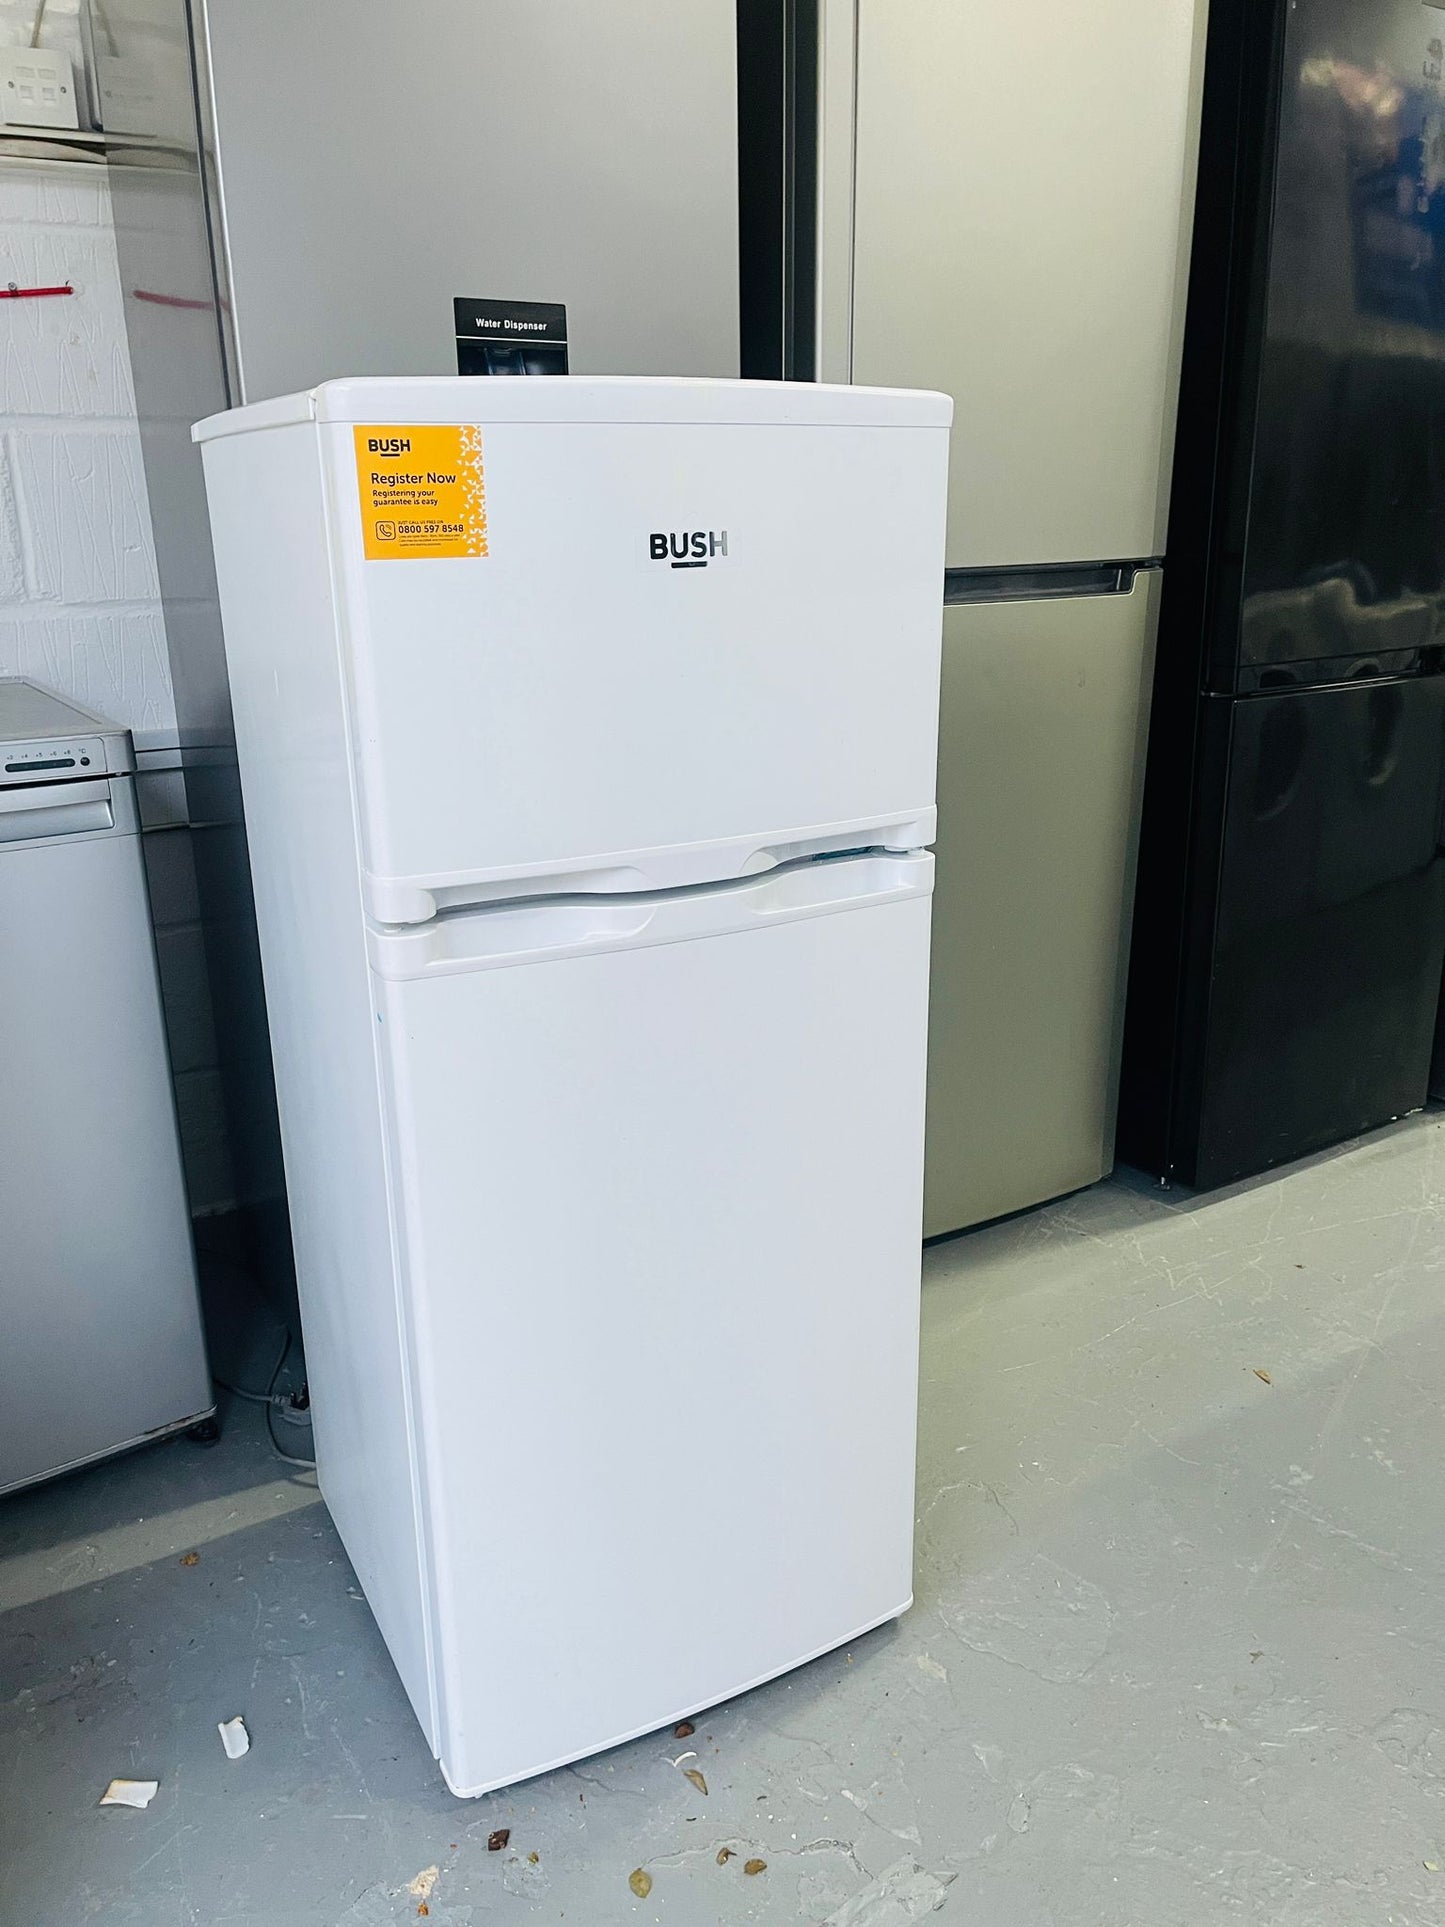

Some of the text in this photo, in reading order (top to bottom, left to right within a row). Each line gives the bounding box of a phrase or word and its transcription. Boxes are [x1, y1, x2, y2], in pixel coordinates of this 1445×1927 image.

[475, 318, 548, 331] Water Dispenser
[368, 439, 411, 452] BUSH
[371, 473, 456, 486] Register Now
[373, 490, 416, 498] Registering
[373, 499, 412, 507] guarantee
[398, 524, 464, 533] 0800 597 8548
[650, 531, 728, 560] BUSH
